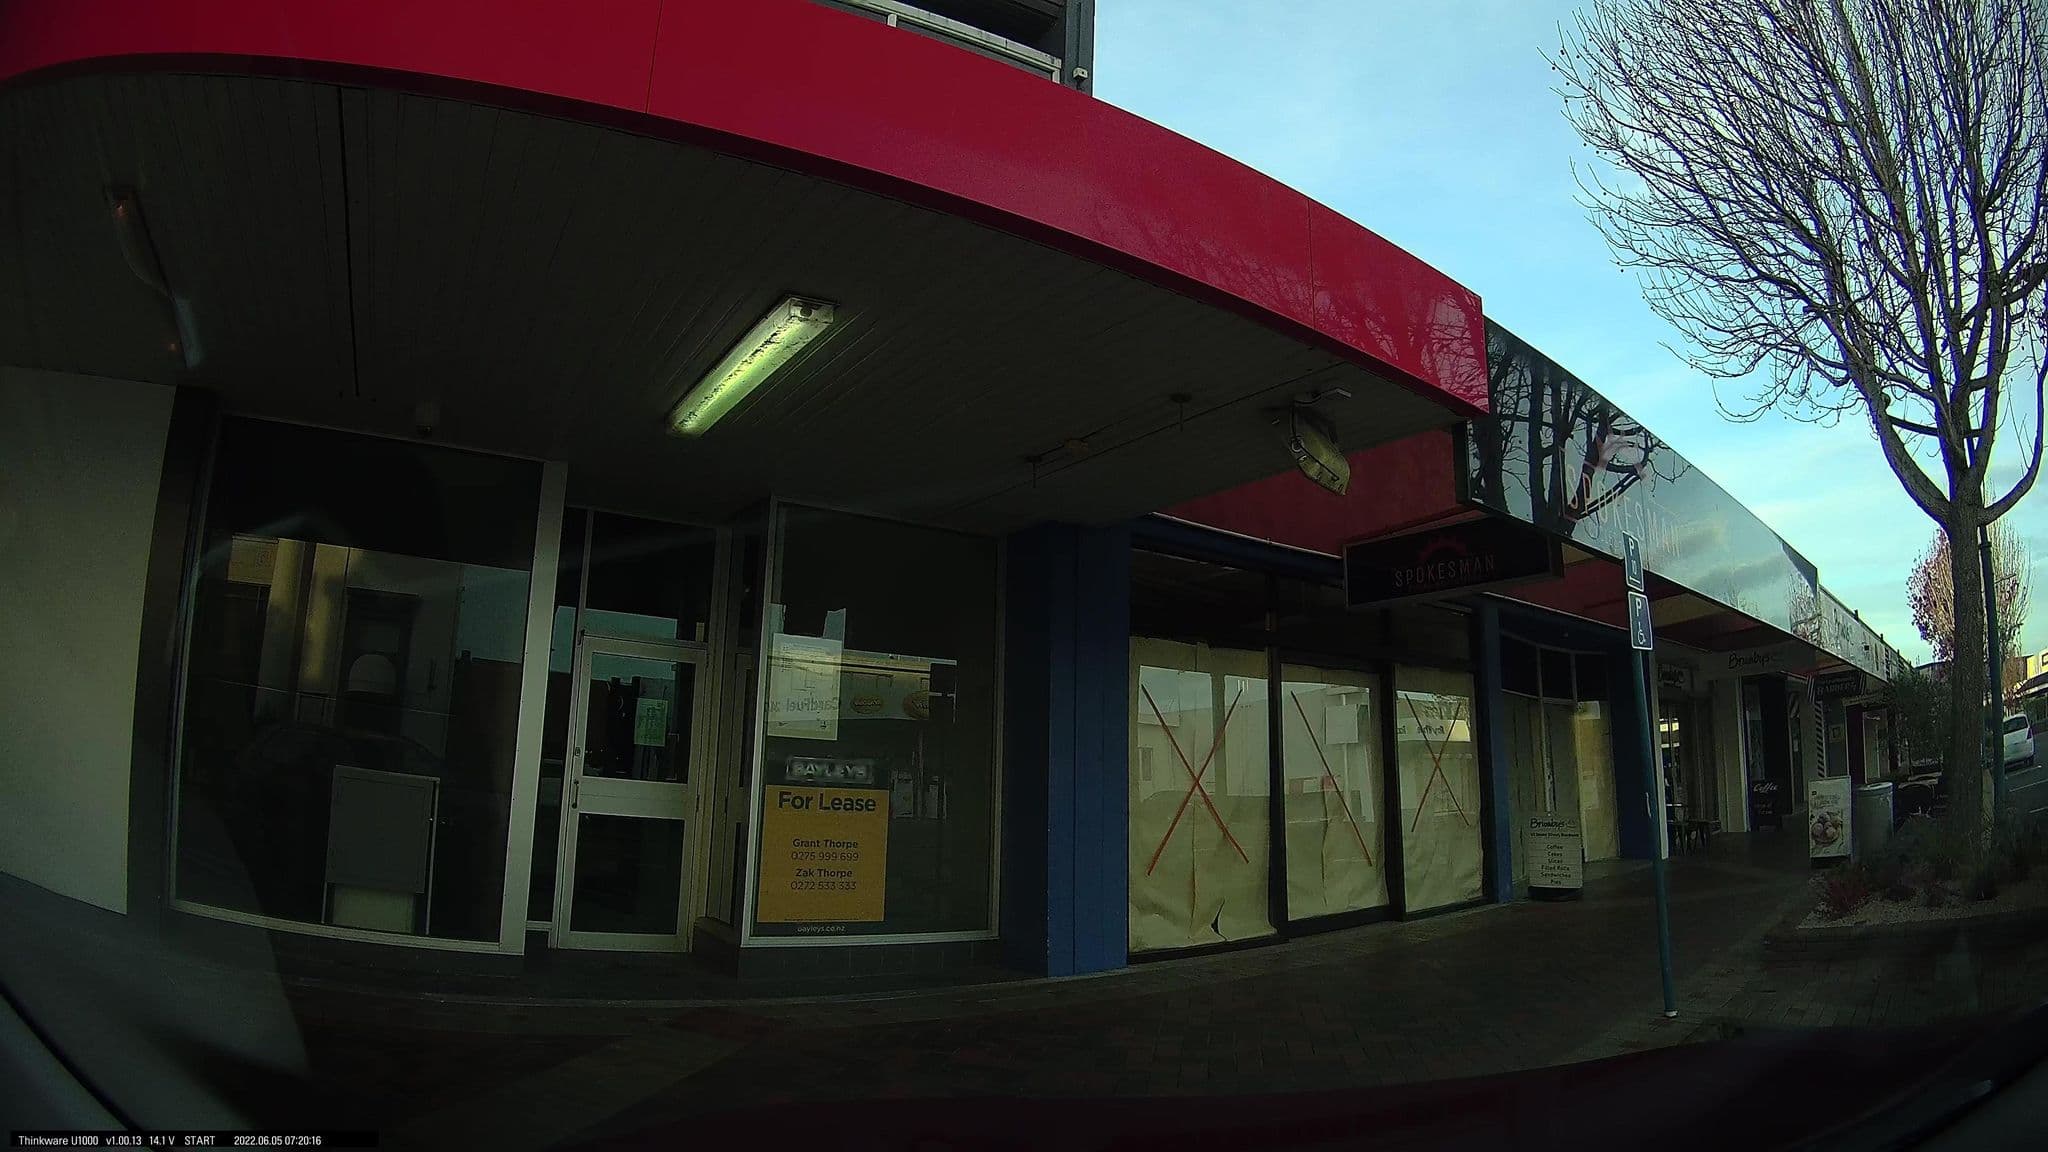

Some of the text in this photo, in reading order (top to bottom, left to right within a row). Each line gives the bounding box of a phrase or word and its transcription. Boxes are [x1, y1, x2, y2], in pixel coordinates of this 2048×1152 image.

[1566, 463, 1682, 560] SPOKESMAN
[1628, 537, 1635, 557] P
[1394, 553, 1496, 588] SPOKESMAN
[1635, 597, 1642, 617] P
[778, 791, 876, 812] For Lease
[792, 838, 858, 850] Grant Thorpe
[790, 851, 859, 862] 0275 999 699
[795, 868, 853, 879] Zak Thorpe
[790, 881, 815, 890] 0272
